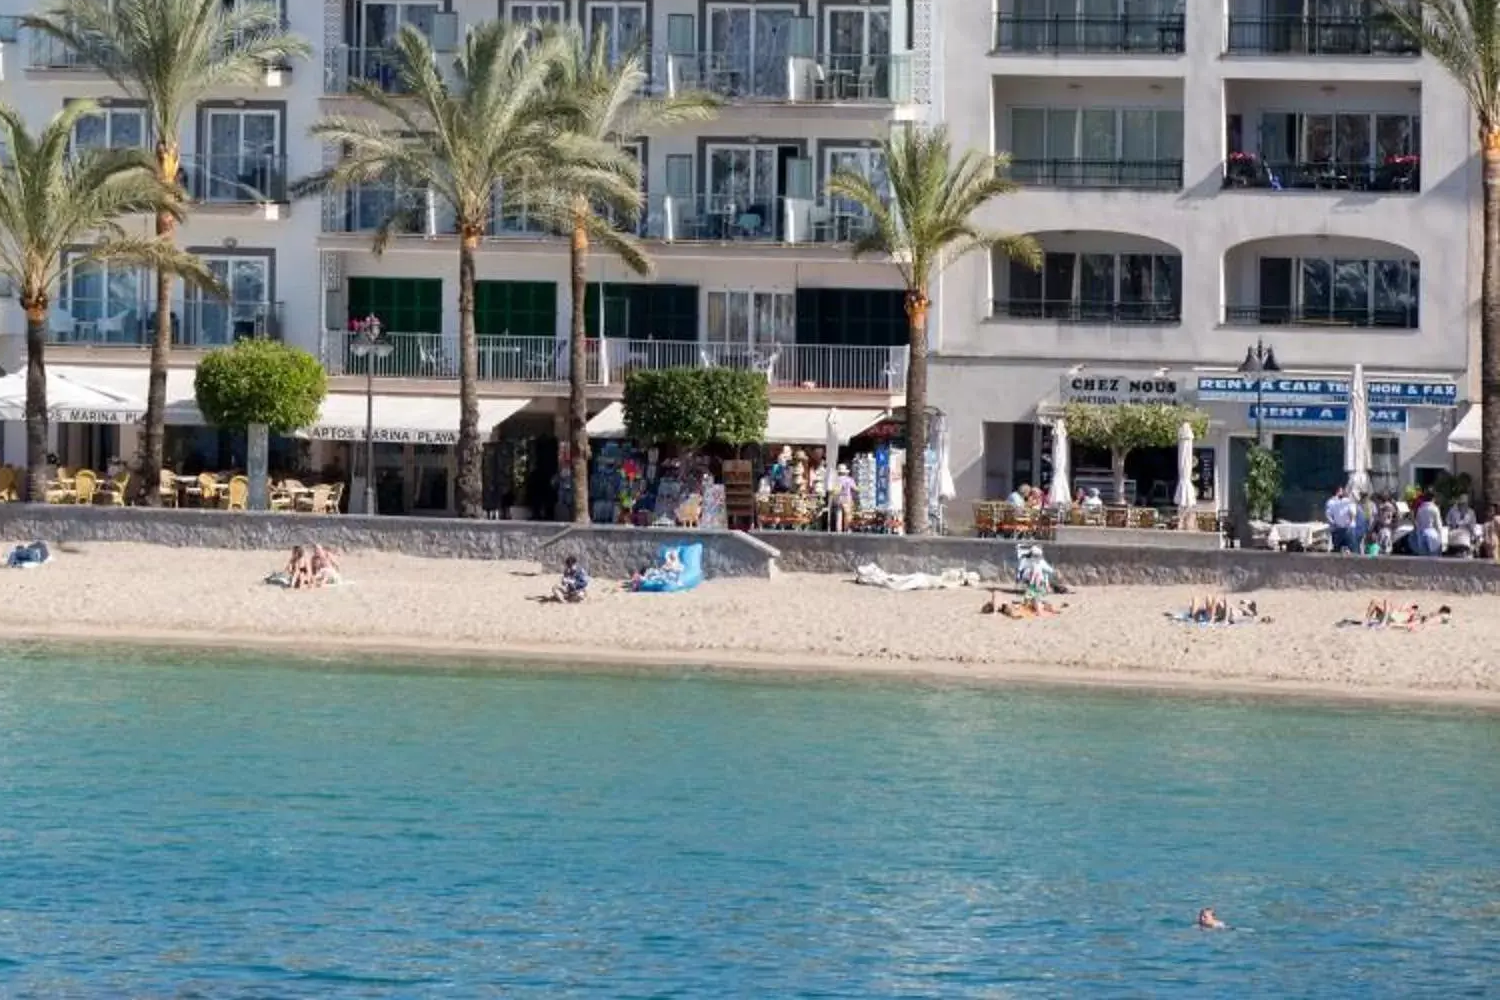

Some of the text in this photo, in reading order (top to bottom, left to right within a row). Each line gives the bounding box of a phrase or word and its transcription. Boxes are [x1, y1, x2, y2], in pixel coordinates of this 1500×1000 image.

[1071, 378, 1177, 393] CHEZ NOUS
[1200, 379, 1254, 390] RENT
[1261, 381, 1274, 390] A
[1280, 380, 1322, 392] CAR
[1423, 384, 1455, 396] FAX
[69, 409, 117, 423] MARINA
[312, 427, 354, 440] APTOS
[417, 431, 456, 443] PLAYA
